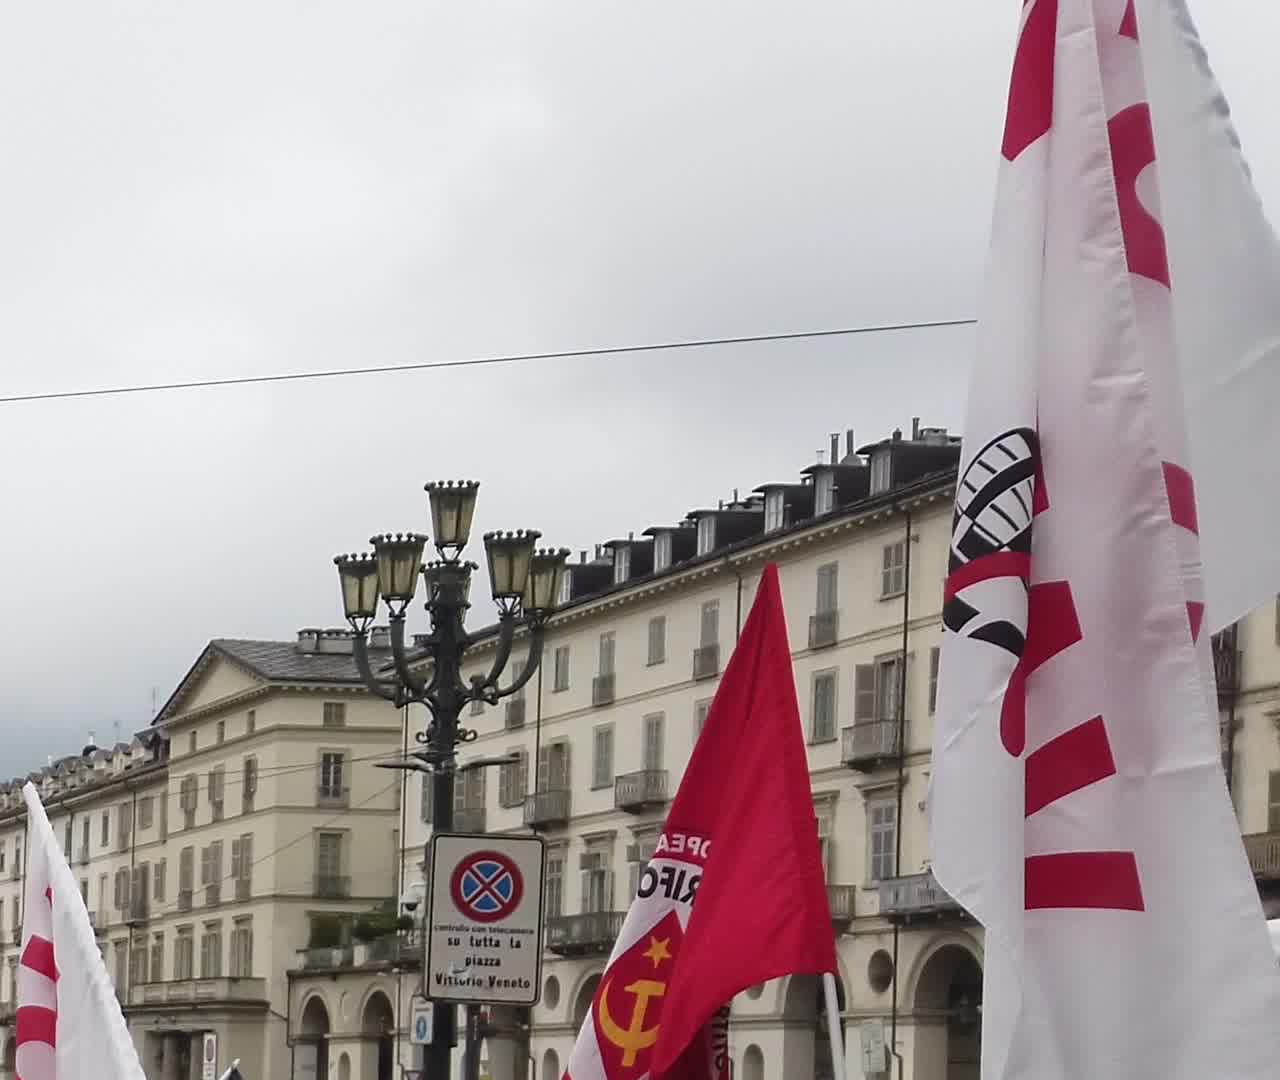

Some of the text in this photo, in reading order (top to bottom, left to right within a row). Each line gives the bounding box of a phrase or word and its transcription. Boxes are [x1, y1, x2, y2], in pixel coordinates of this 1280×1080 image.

[447, 935, 522, 949] su tutta la
[465, 954, 501, 967] piazza
[435, 973, 530, 989] Vittorio Veneto
